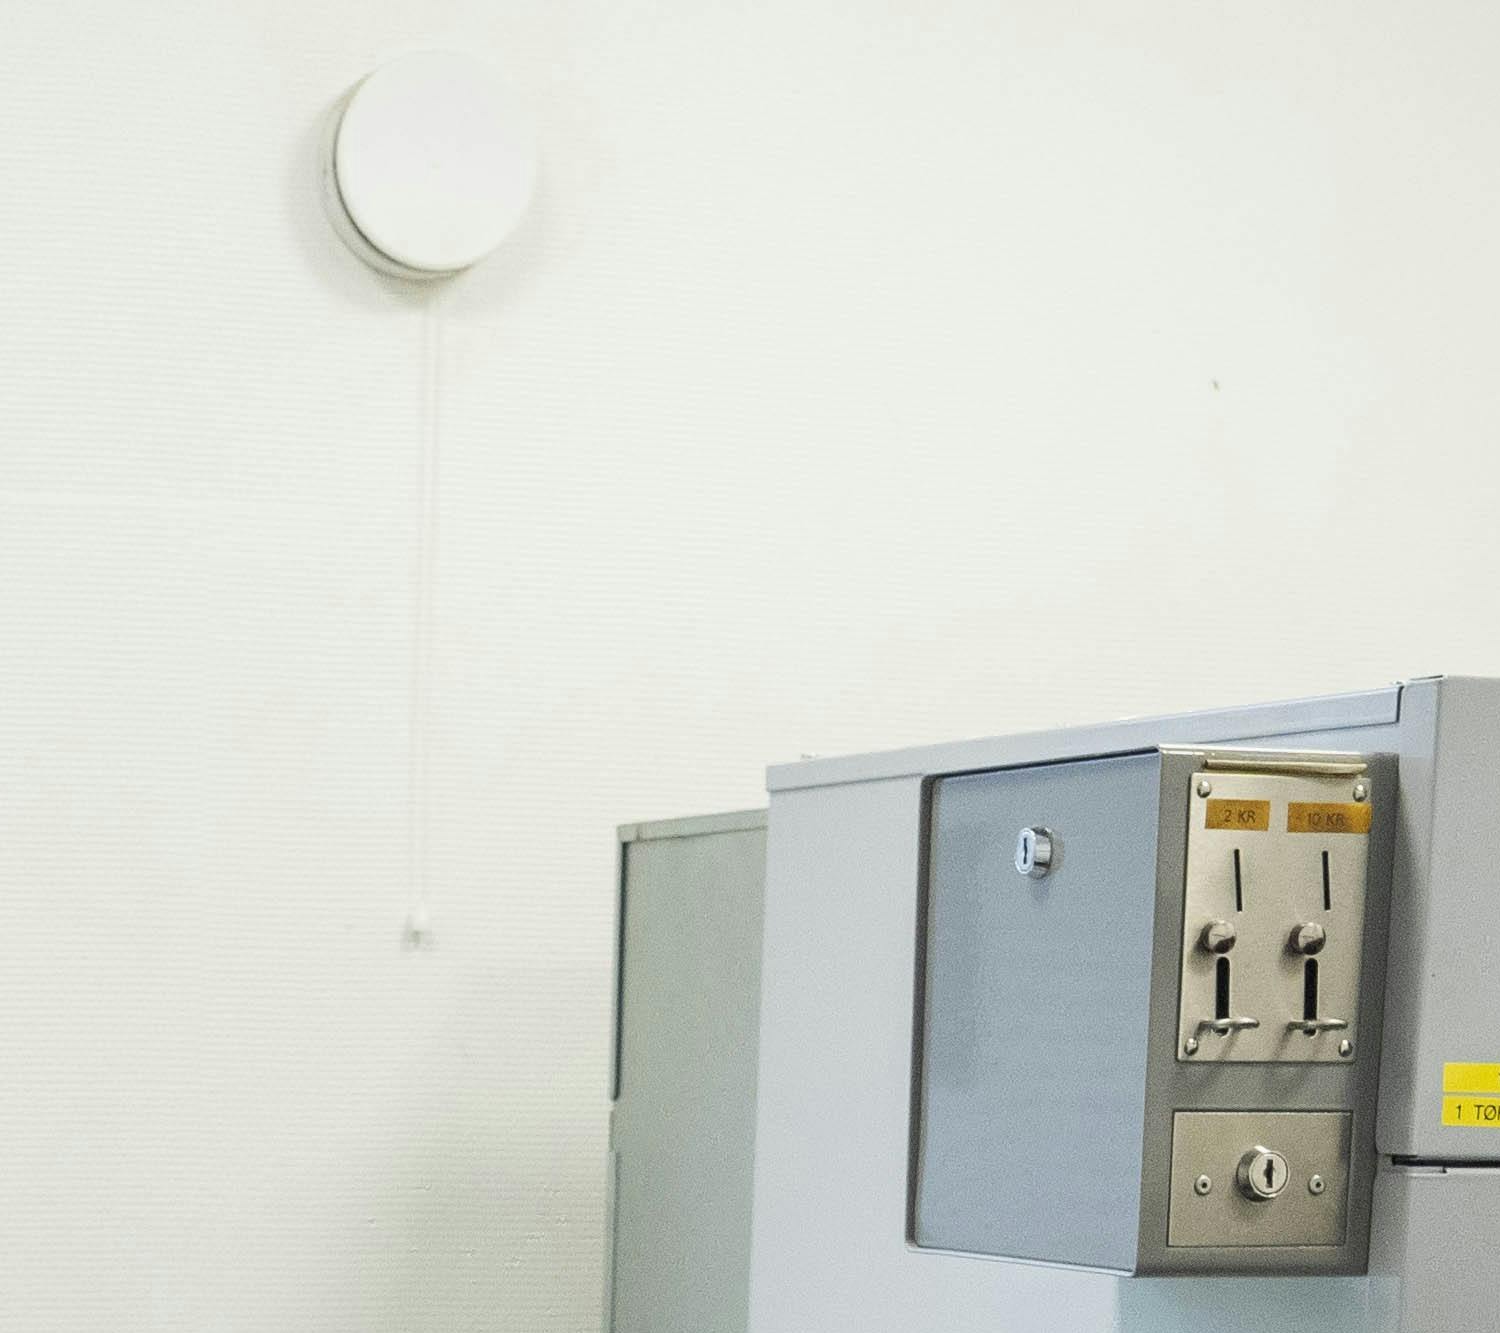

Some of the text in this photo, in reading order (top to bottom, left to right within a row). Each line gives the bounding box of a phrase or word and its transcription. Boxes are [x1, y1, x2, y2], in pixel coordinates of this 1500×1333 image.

[1223, 810, 1256, 824] 2 KR
[1307, 813, 1346, 827] 10 KR
[1456, 1105, 1461, 1119] 1
